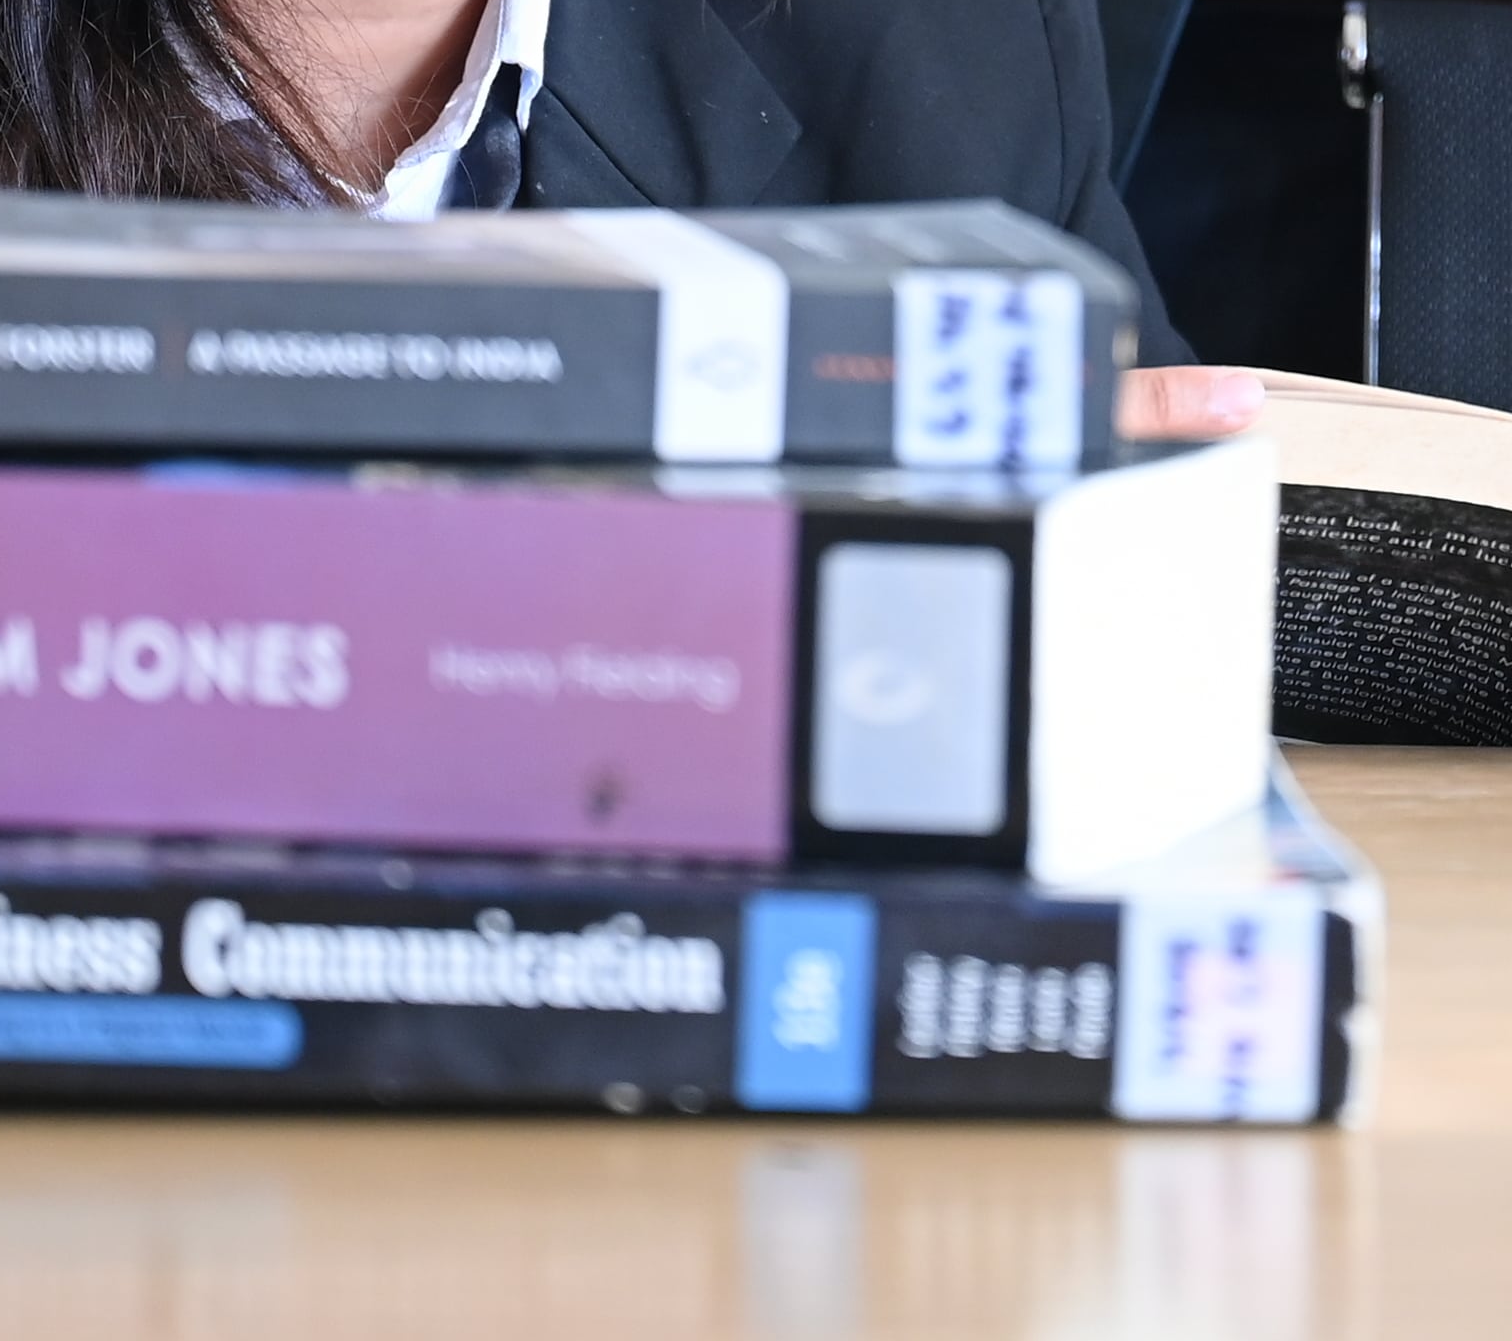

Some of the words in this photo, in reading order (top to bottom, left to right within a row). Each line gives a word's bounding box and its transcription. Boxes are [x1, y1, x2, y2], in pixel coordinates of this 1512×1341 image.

[186, 329, 222, 377] A
[222, 329, 389, 381] PASSAGE
[389, 333, 449, 382] TO
[449, 335, 565, 384] INDIA
[1276, 526, 1381, 543] rescience
[1388, 537, 1433, 550] and
[1441, 542, 1467, 556] its
[1279, 514, 1337, 526] great
[1346, 516, 1402, 533] book
[1280, 589, 1340, 602] caught
[1347, 596, 1363, 605] in
[1371, 598, 1397, 610] the
[1405, 606, 1452, 621] great
[1285, 568, 1351, 581] portrait
[1357, 574, 1376, 583] of
[1381, 577, 1393, 586] a
[1400, 582, 1461, 600] society
[1468, 595, 1483, 605] in
[1289, 577, 1361, 593] Passage
[1368, 586, 1384, 596] to
[1391, 589, 1435, 606] India
[1442, 601, 1503, 624] depicts
[1283, 612, 1344, 625] elderly
[1353, 621, 1449, 646] companion
[1458, 643, 1490, 659] Mrs
[1304, 602, 1323, 611] of
[1331, 605, 1370, 617] their
[1430, 621, 1442, 631] It
[1450, 626, 1506, 652] begins
[1317, 626, 1358, 638] town
[1366, 633, 1385, 643] of
[59, 614, 350, 711] JONES
[1274, 633, 1292, 641] its
[1298, 635, 1355, 649] insular
[1360, 644, 1395, 656] and
[1398, 652, 1490, 685] prejudiced
[1274, 645, 1347, 659] ermined
[1358, 654, 1374, 664] to
[1385, 661, 1452, 684] explore
[1463, 682, 1488, 697] the
[1276, 655, 1301, 664] the
[1310, 660, 1390, 679] guidance
[1398, 676, 1415, 684] of
[1423, 682, 1447, 695] the
[1273, 686, 1367, 709] l-respected
[1373, 705, 1427, 725] doctor
[1433, 724, 1471, 743] soon
[1283, 679, 1311, 687] are
[1322, 684, 1402, 708] exploring
[1413, 703, 1437, 717] the
[1321, 671, 1349, 683] But
[1354, 678, 1365, 686] a
[1371, 682, 1457, 711] mysterious
[182, 898, 726, 1014] Communication
